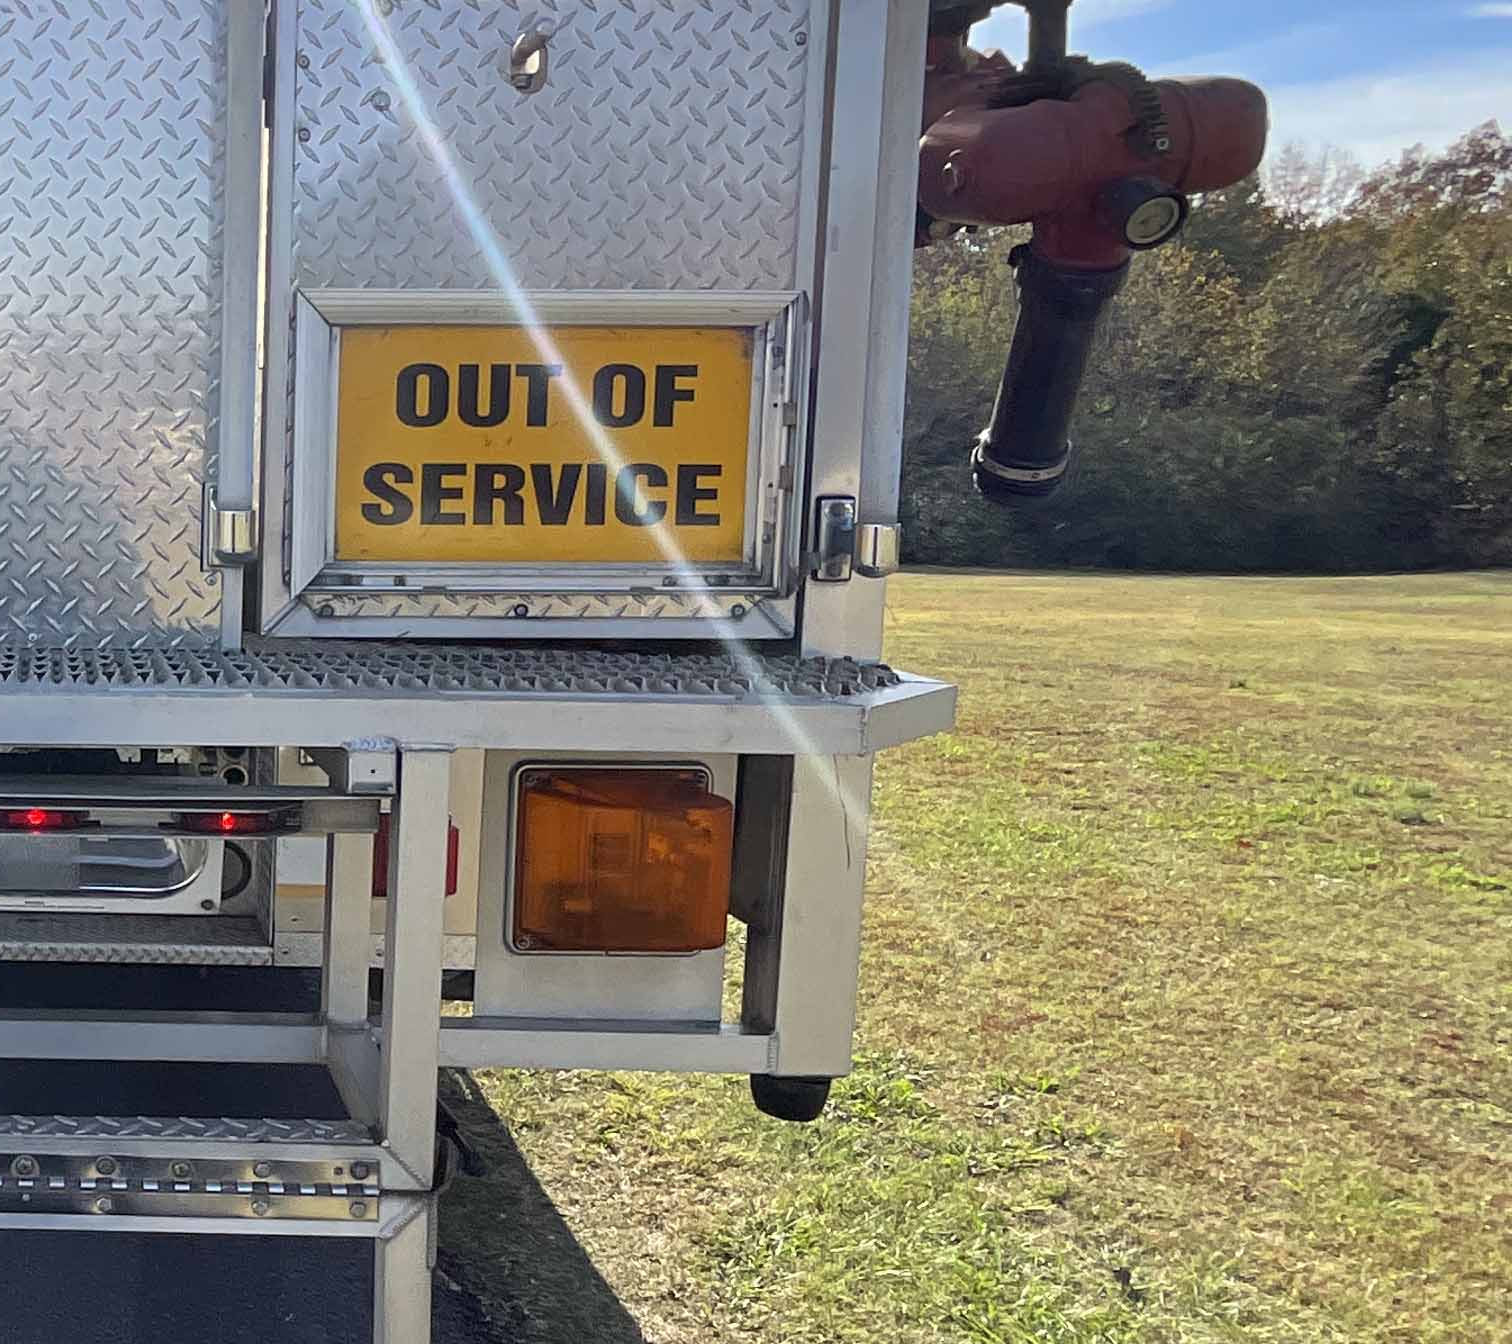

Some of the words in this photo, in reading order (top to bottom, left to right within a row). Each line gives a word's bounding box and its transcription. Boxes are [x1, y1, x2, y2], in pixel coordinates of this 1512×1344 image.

[395, 362, 562, 428] OUT
[591, 363, 699, 428] OF
[361, 462, 723, 527] SERVICE
